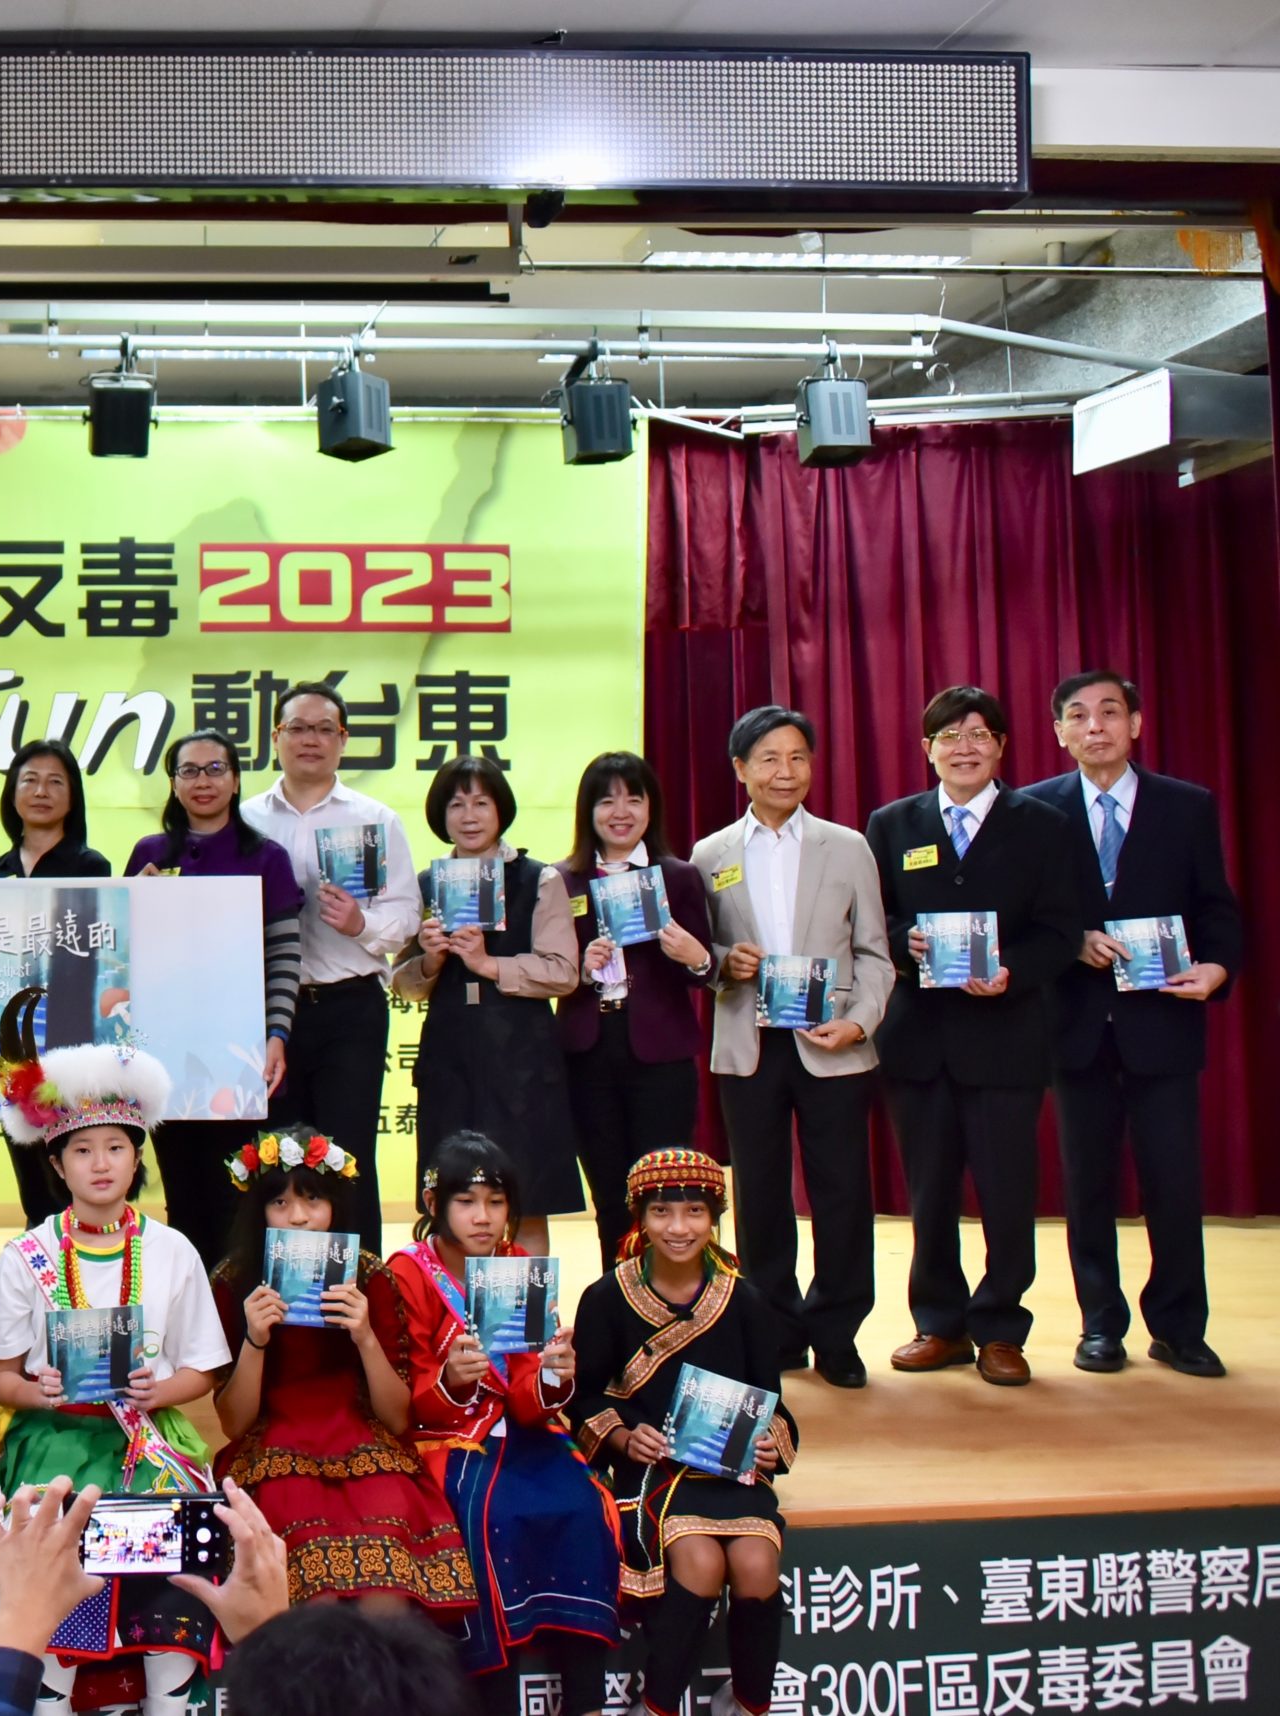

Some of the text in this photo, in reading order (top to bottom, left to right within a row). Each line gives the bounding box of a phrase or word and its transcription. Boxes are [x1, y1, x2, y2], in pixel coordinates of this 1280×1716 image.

[200, 544, 512, 633] 2023
[191, 669, 512, 772] 動台東
